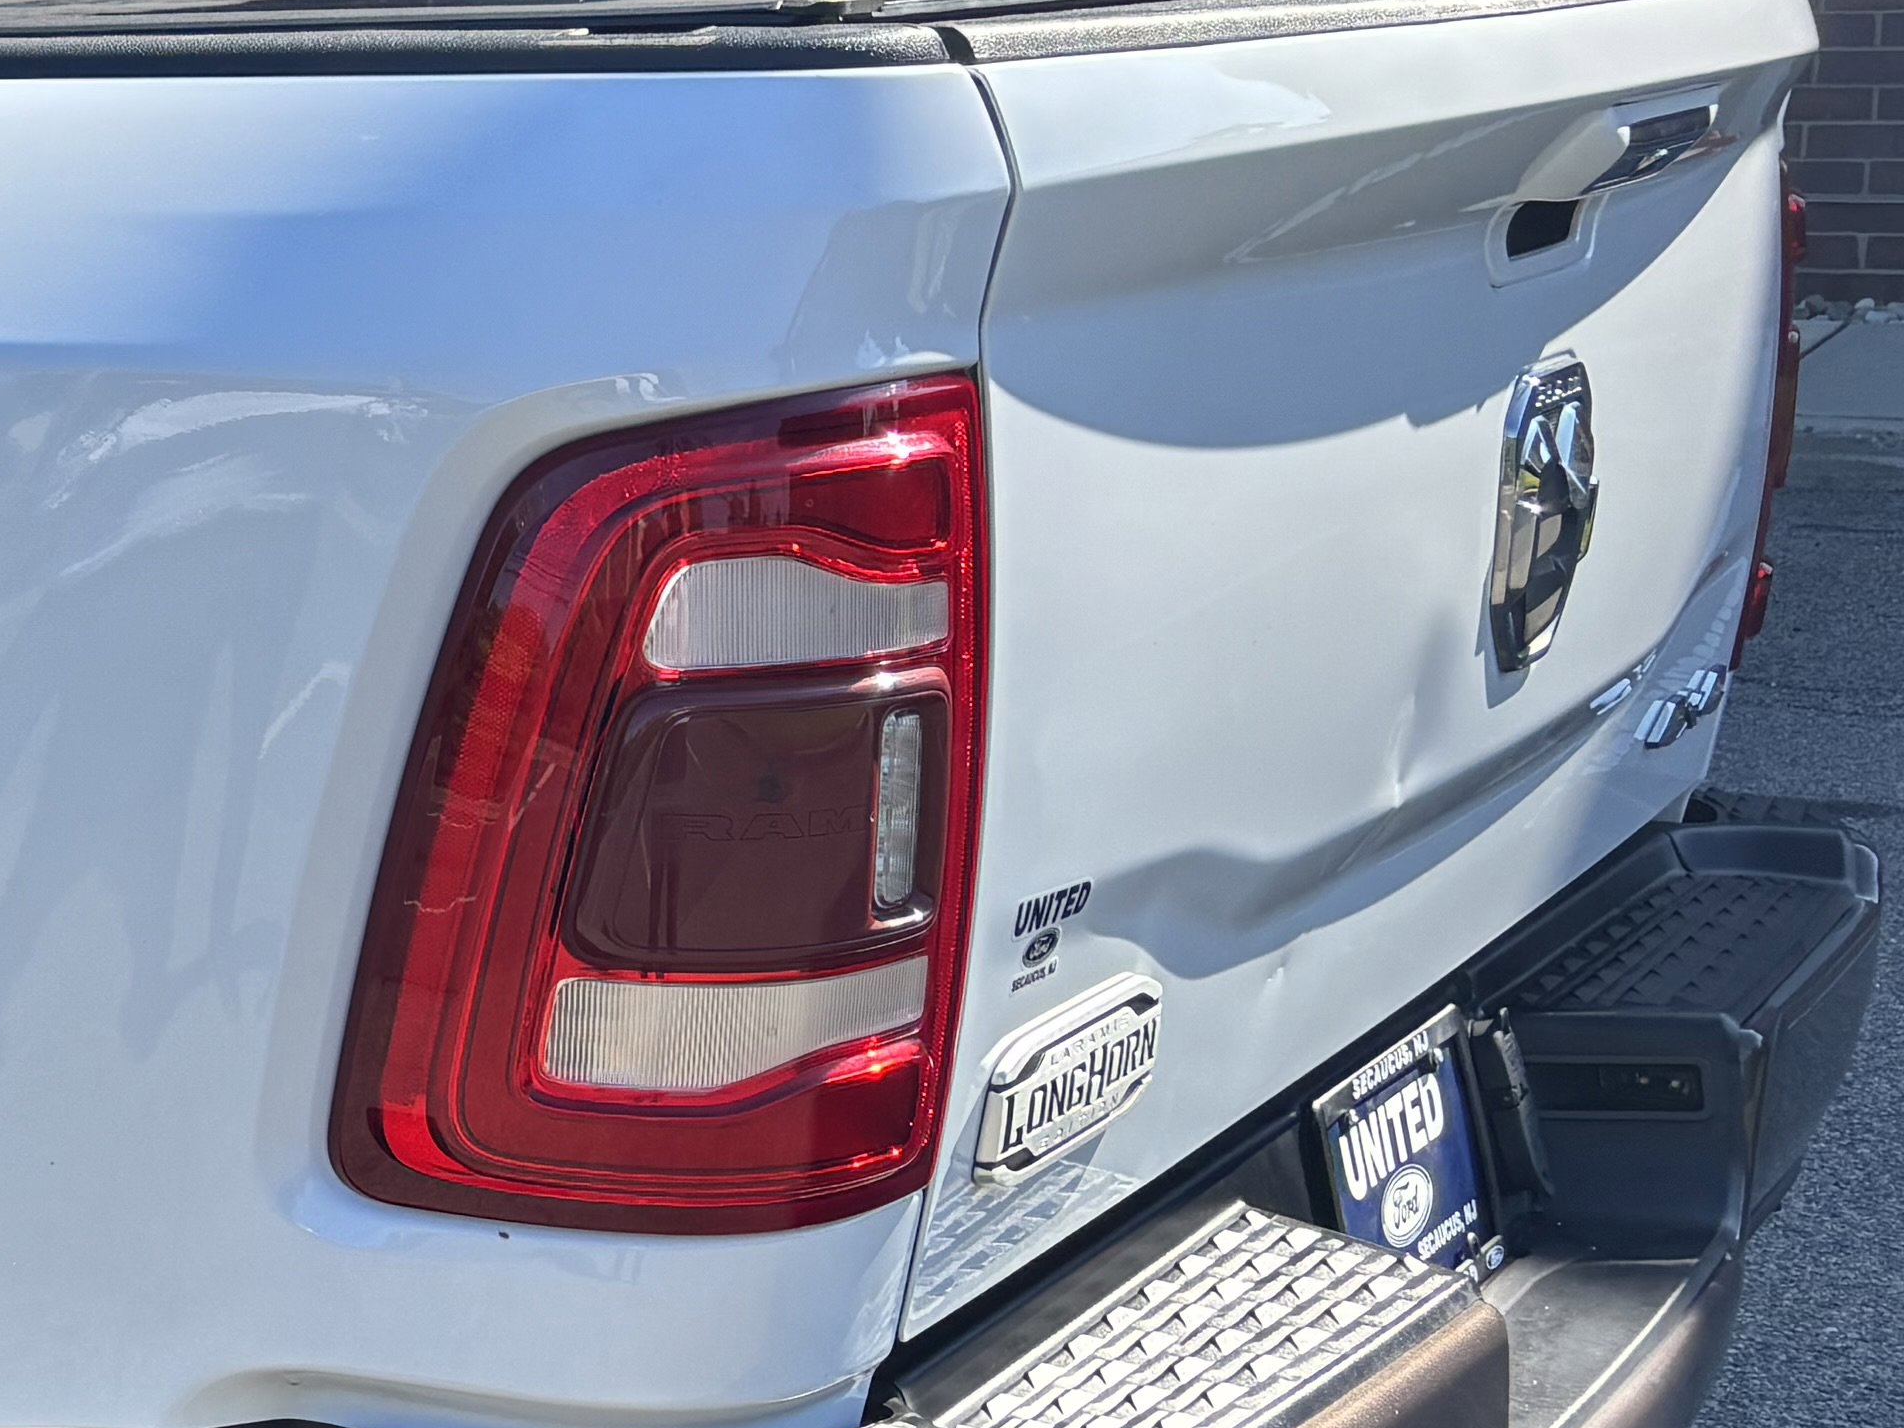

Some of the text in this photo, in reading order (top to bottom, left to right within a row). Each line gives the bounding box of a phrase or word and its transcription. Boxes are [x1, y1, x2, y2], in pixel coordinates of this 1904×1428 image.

[659, 804, 868, 841] RAM
[1014, 881, 1092, 937] UNITED
[1413, 1030, 1429, 1058] NJ
[1338, 1073, 1444, 1200] UNITED
[1463, 1199, 1478, 1225] NJ
